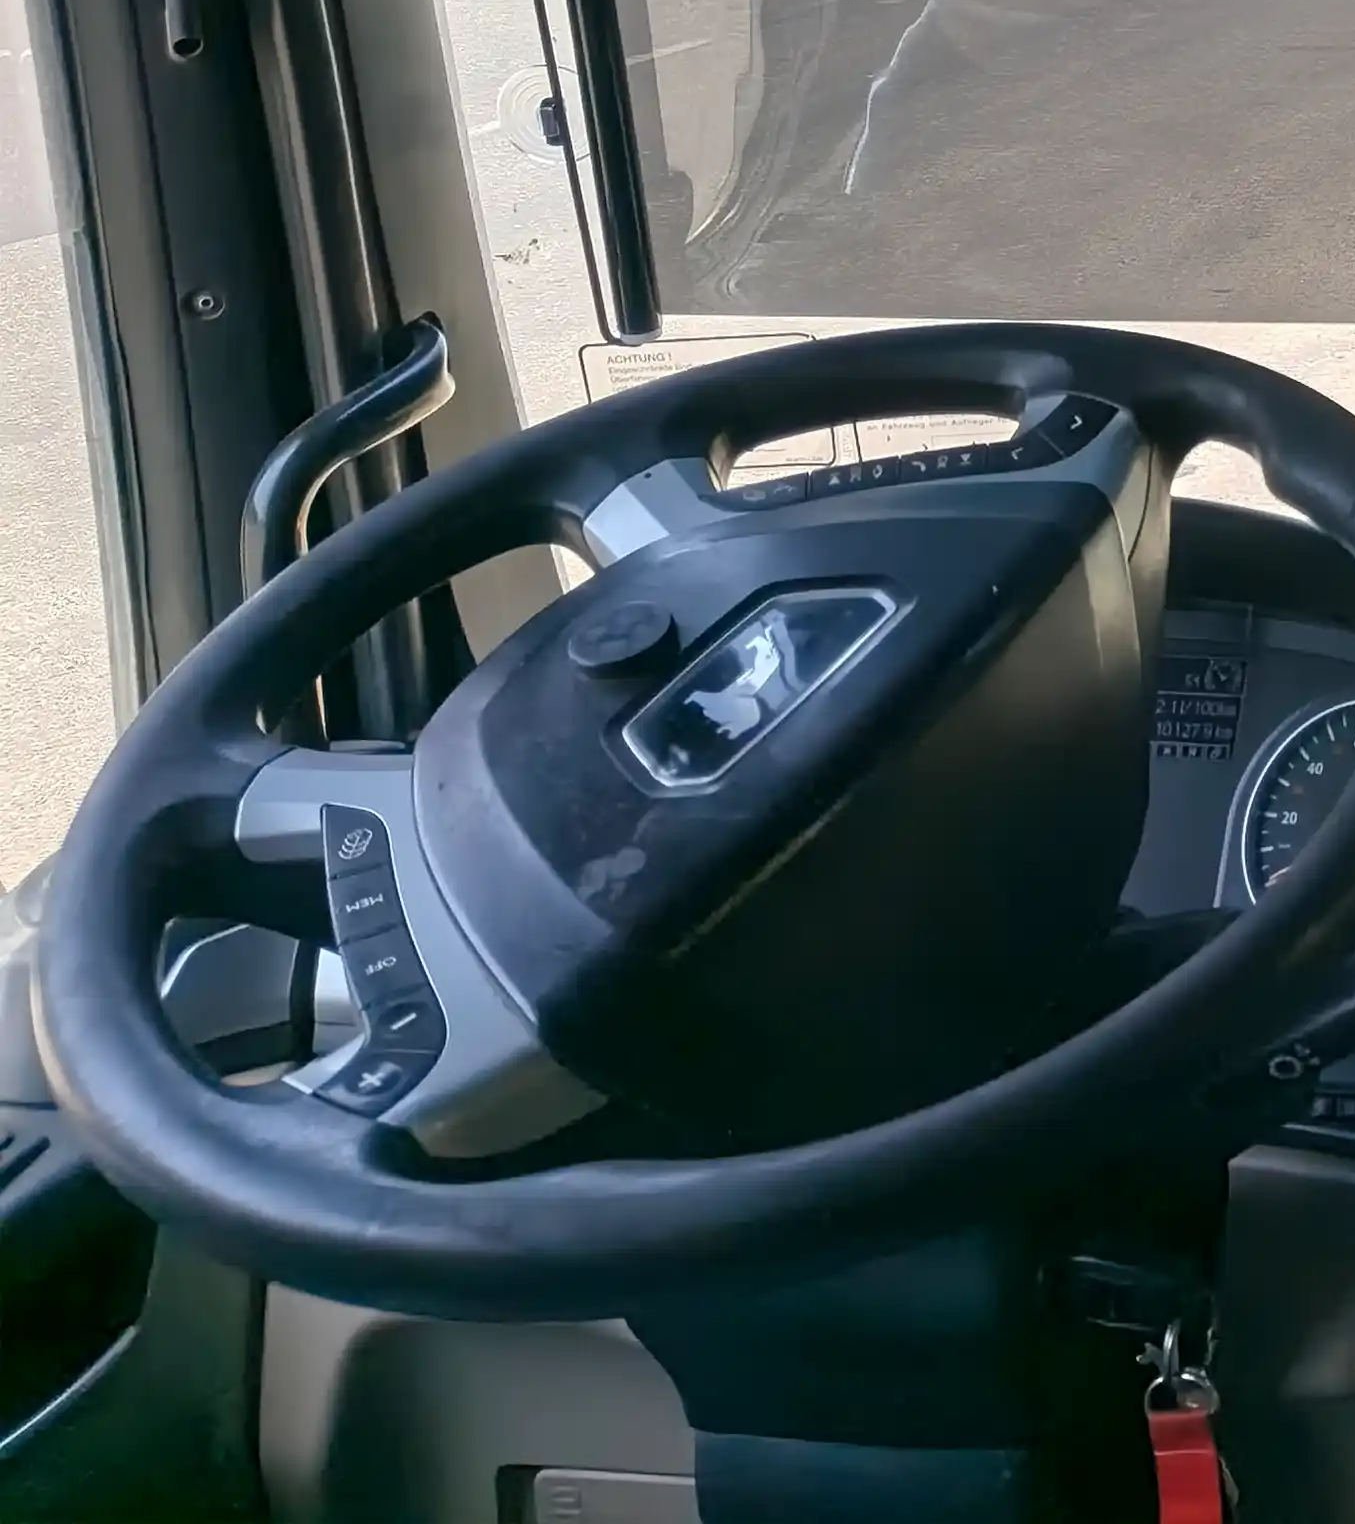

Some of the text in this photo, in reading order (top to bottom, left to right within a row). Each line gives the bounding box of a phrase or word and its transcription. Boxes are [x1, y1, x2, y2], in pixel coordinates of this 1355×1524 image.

[1306, 762, 1323, 775] 40
[1281, 811, 1298, 824] 20
[345, 893, 384, 913] MEM
[364, 956, 397, 976] OFF
